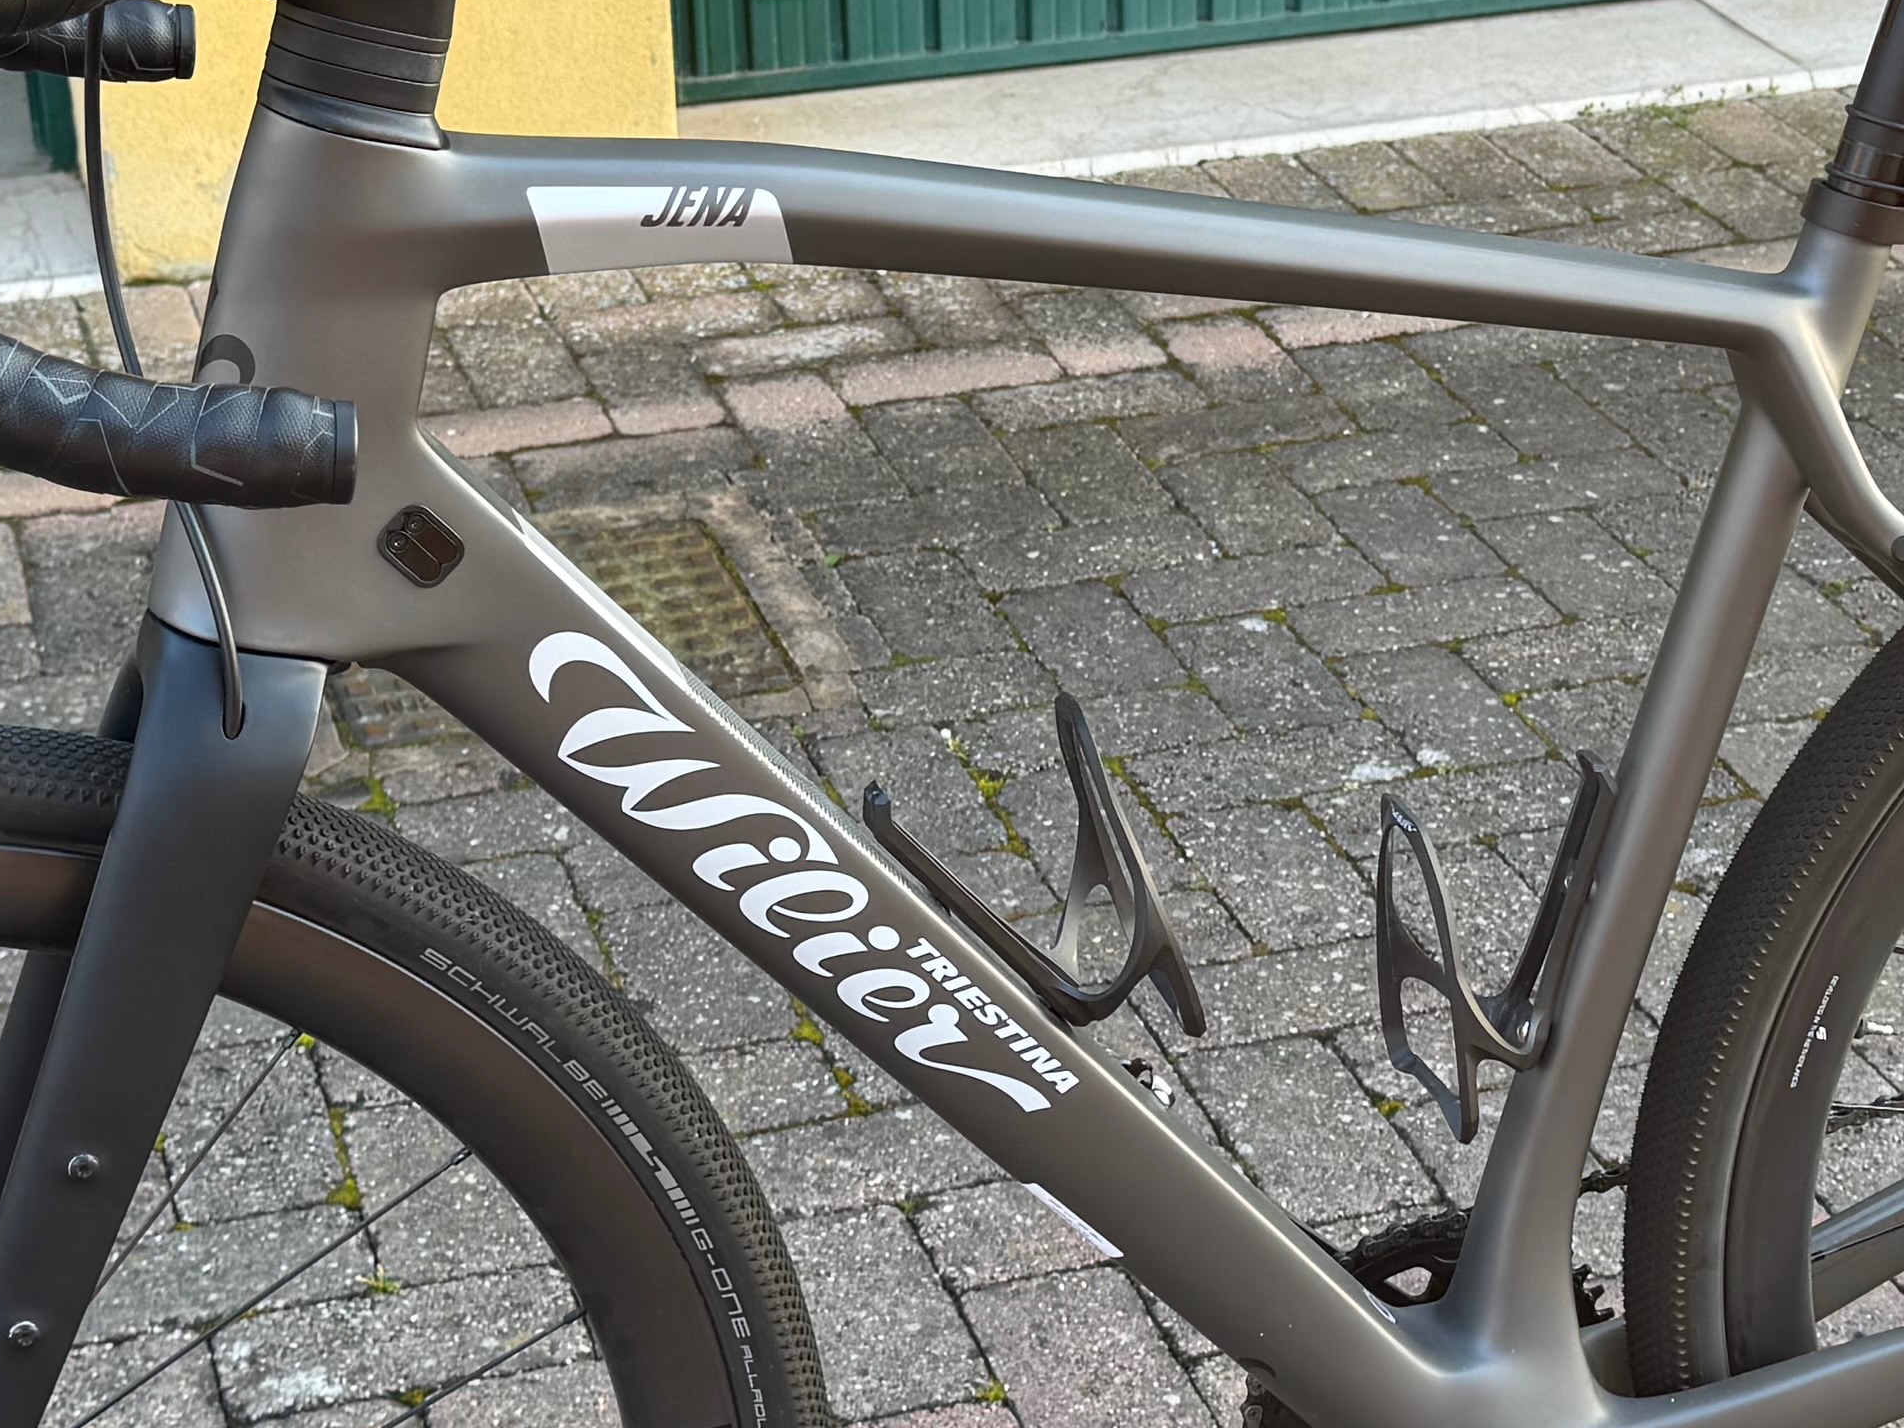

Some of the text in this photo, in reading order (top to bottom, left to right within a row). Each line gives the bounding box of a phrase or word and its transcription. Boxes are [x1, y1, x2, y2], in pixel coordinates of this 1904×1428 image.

[640, 186, 756, 228] JENA
[529, 631, 1052, 1113] Wilier
[419, 947, 608, 1101] SCHWALBE
[692, 1228, 751, 1339] G-ONE
[905, 937, 1081, 1095] TRIESTINA
